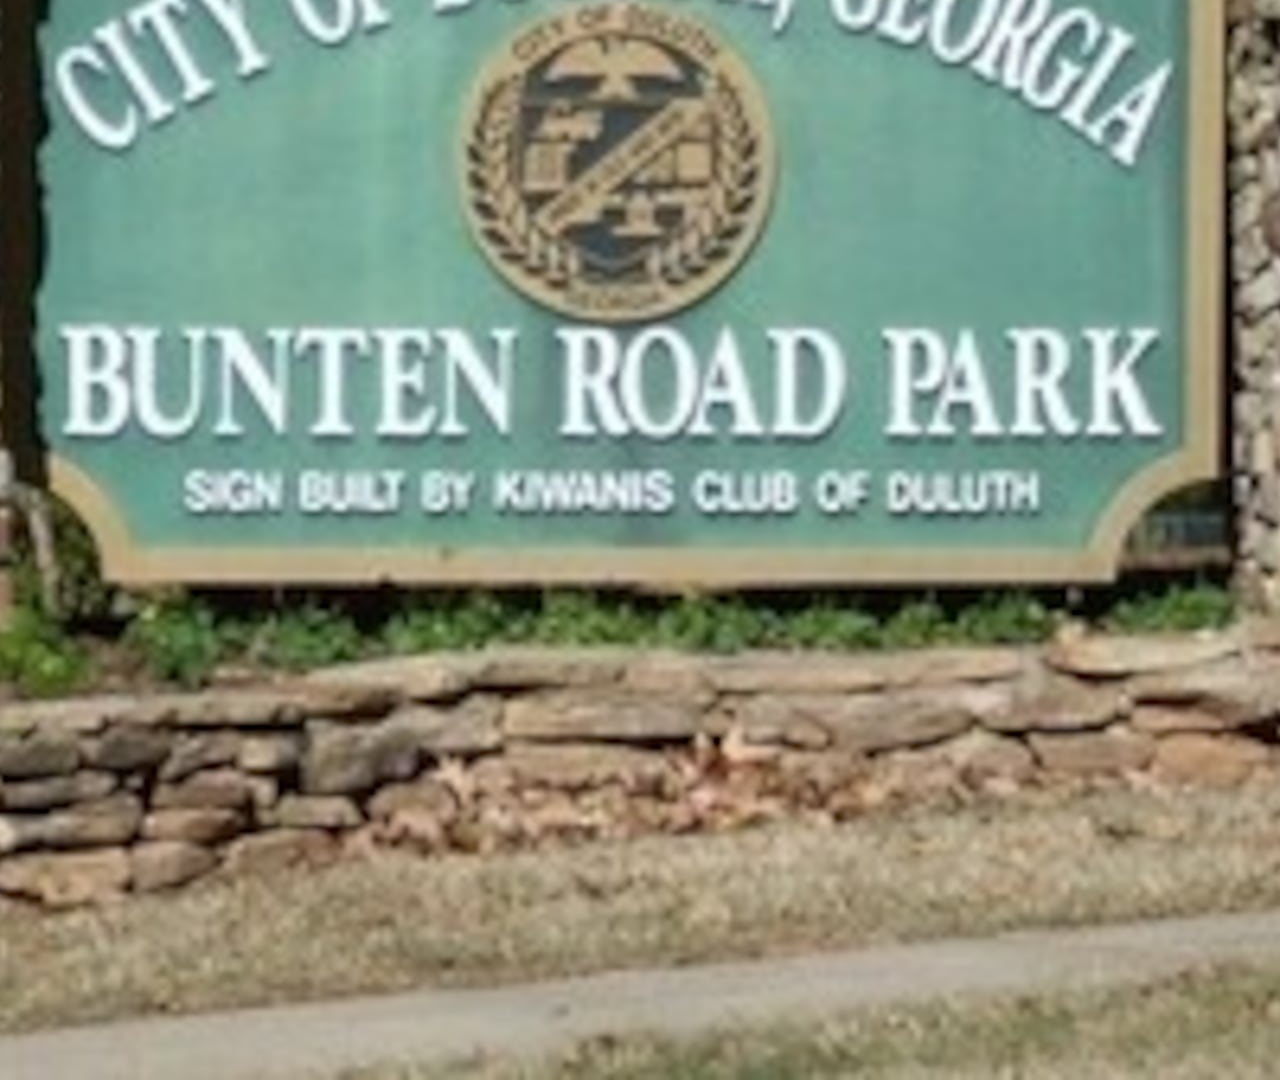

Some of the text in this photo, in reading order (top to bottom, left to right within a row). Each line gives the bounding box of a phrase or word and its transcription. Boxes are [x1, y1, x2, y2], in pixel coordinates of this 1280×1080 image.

[511, 4, 720, 61] CITY OF DULUTH
[61, 323, 1162, 437] BUNTEN ROAD PARK
[184, 468, 1040, 512] SIGN BUILT BY KIWANIS CLUB OF DULUTH
